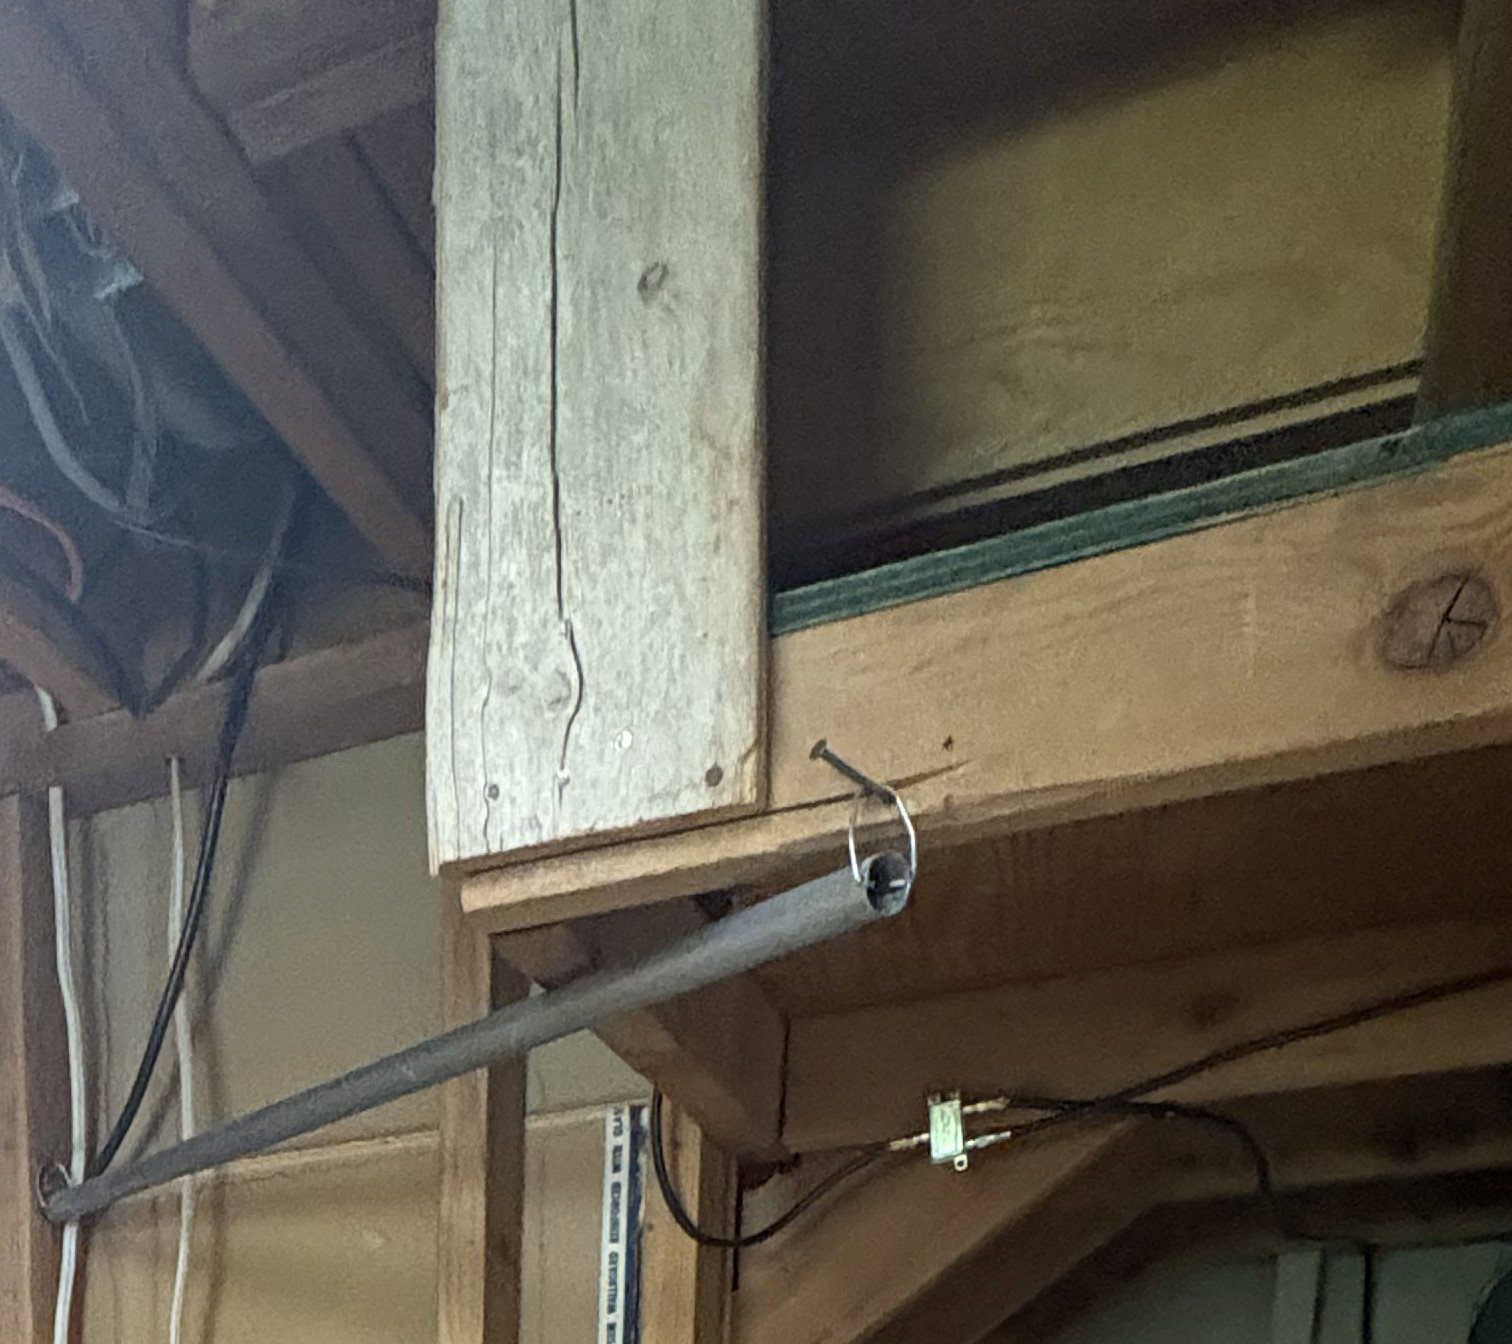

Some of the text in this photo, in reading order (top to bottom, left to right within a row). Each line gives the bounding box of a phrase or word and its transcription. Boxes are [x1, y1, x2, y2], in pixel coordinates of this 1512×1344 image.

[612, 1145, 623, 1173] WITH
[610, 1181, 622, 1243] REINFORCED
[608, 1252, 618, 1314] WALLBOARD
